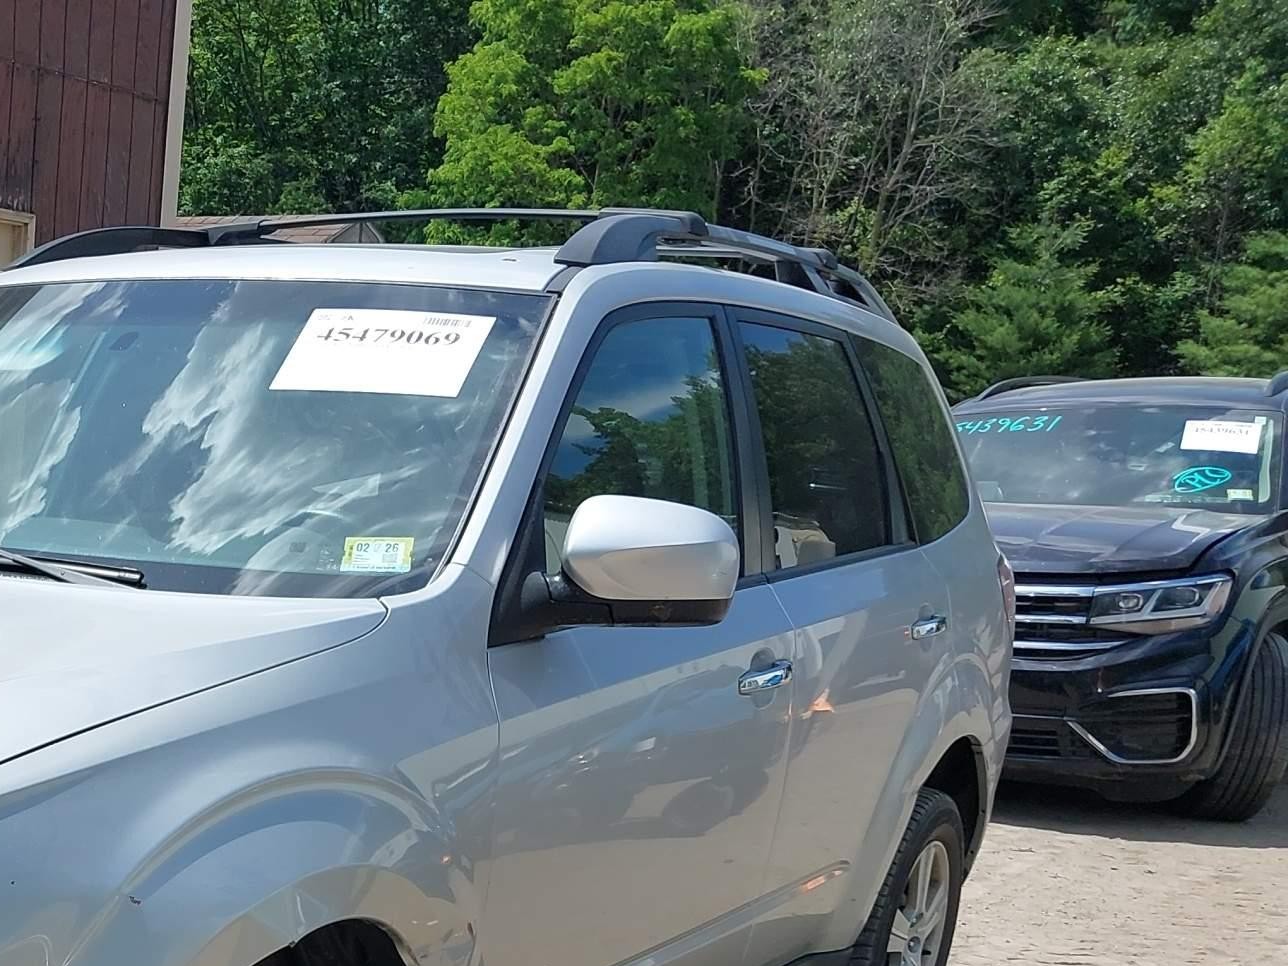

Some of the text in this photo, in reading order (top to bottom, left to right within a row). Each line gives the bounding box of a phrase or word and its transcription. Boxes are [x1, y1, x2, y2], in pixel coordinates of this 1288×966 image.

[317, 326, 462, 346] 45479069
[356, 542, 400, 553] 02 26
